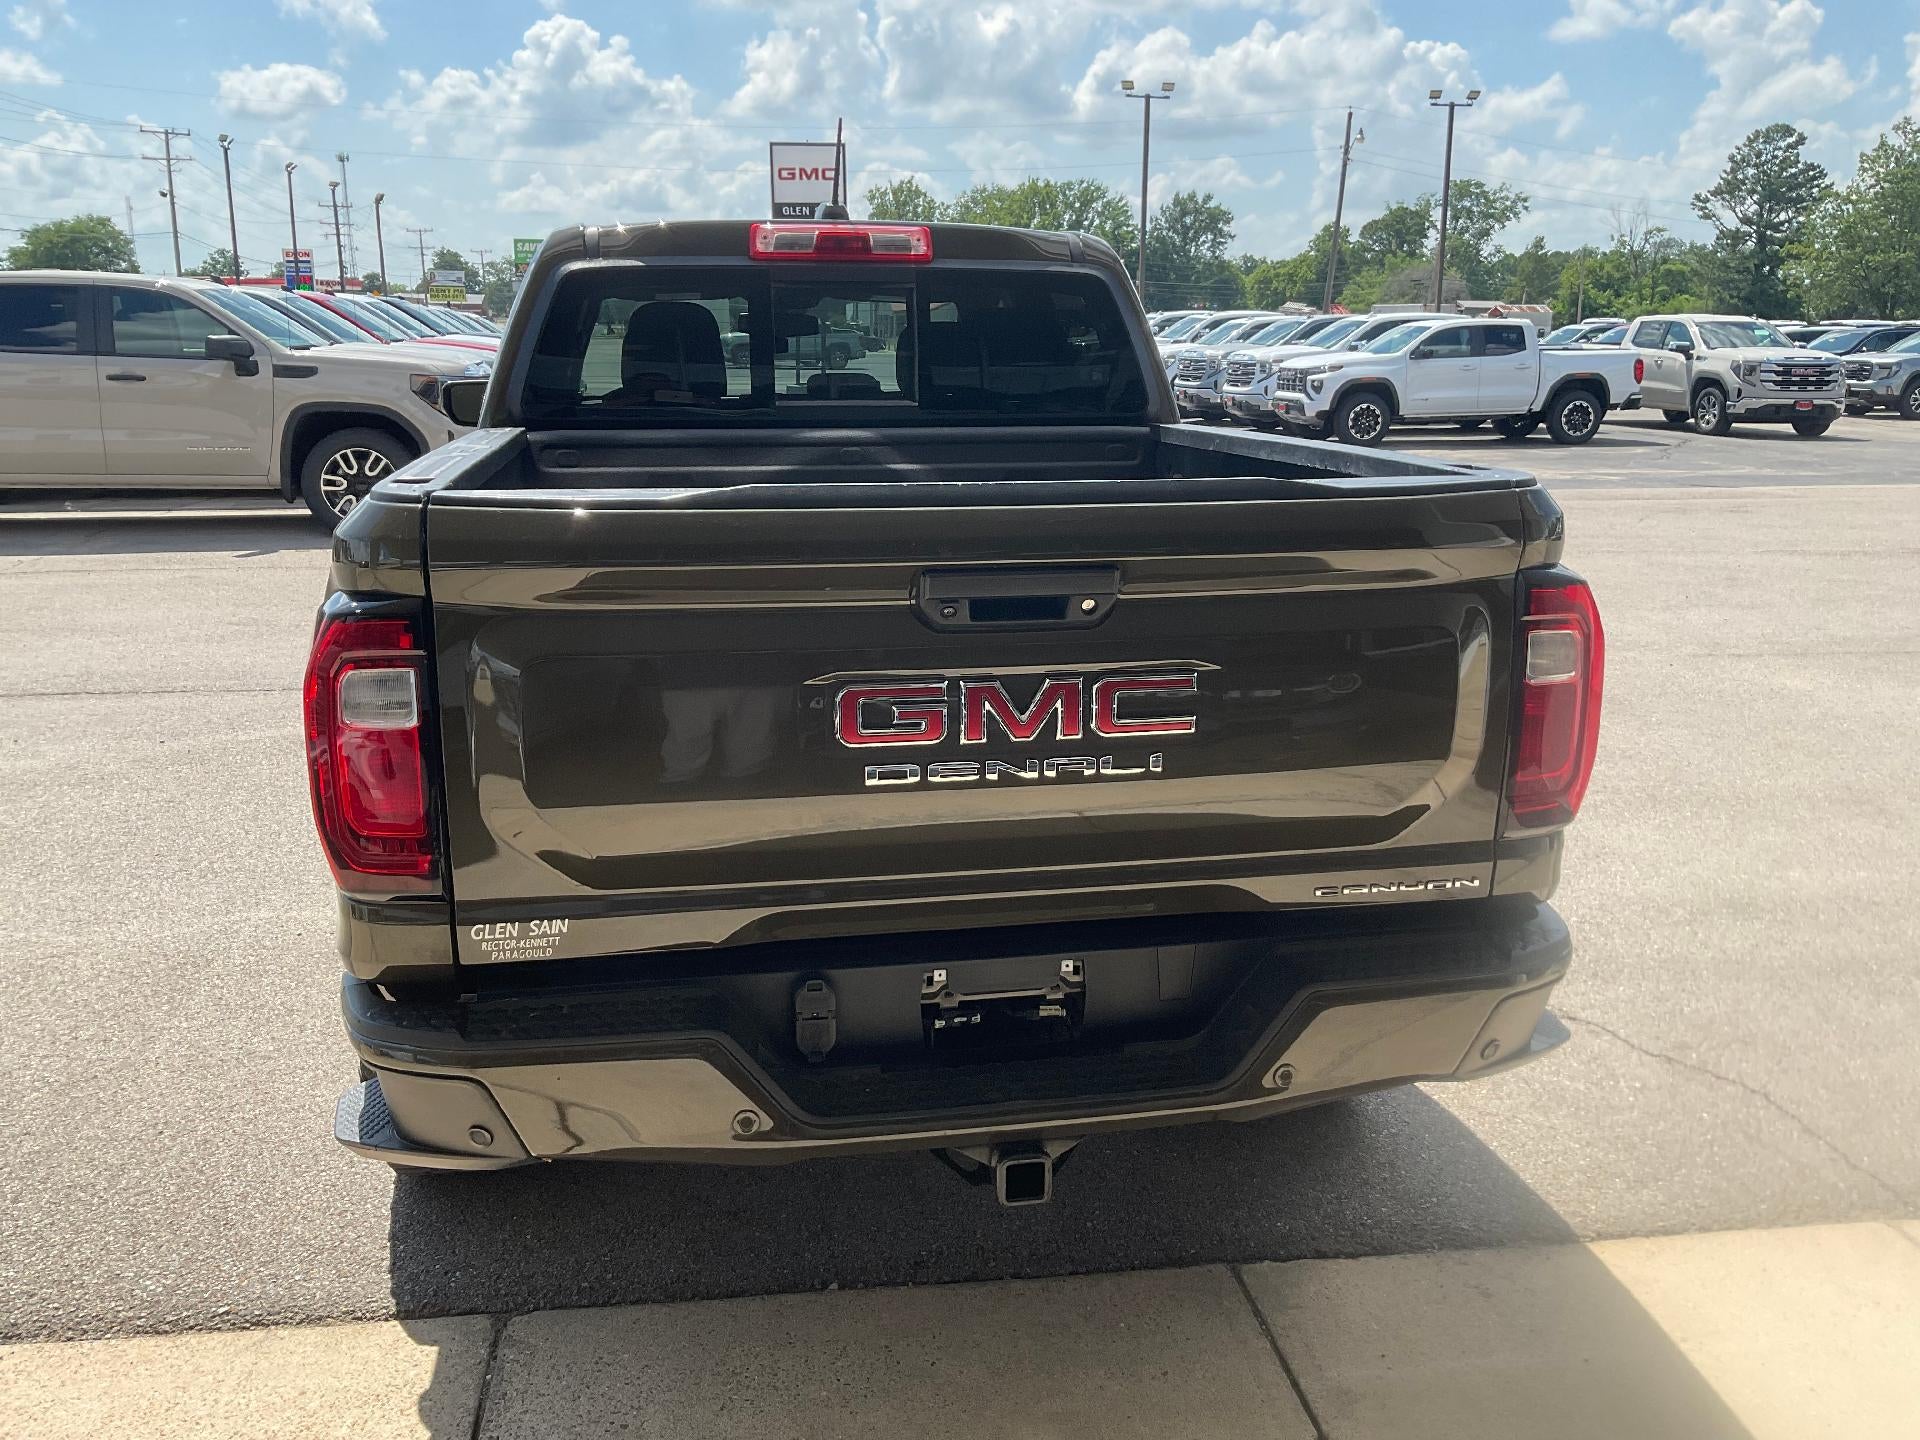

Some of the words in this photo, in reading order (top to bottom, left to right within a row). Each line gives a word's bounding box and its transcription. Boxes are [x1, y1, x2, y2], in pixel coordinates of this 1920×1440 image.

[778, 167, 835, 181] GMC
[782, 206, 810, 216] GLEN
[516, 242, 540, 252] SAV
[1791, 368, 1820, 376] GMC
[834, 672, 1198, 748] GMC
[864, 751, 1164, 787] DENALI
[1313, 876, 1481, 898] CANYON
[470, 922, 519, 940] GLEN
[528, 918, 569, 935] SAIN
[481, 936, 561, 951] RECTOR-KENNETT
[491, 948, 553, 960] PARAGOULD
